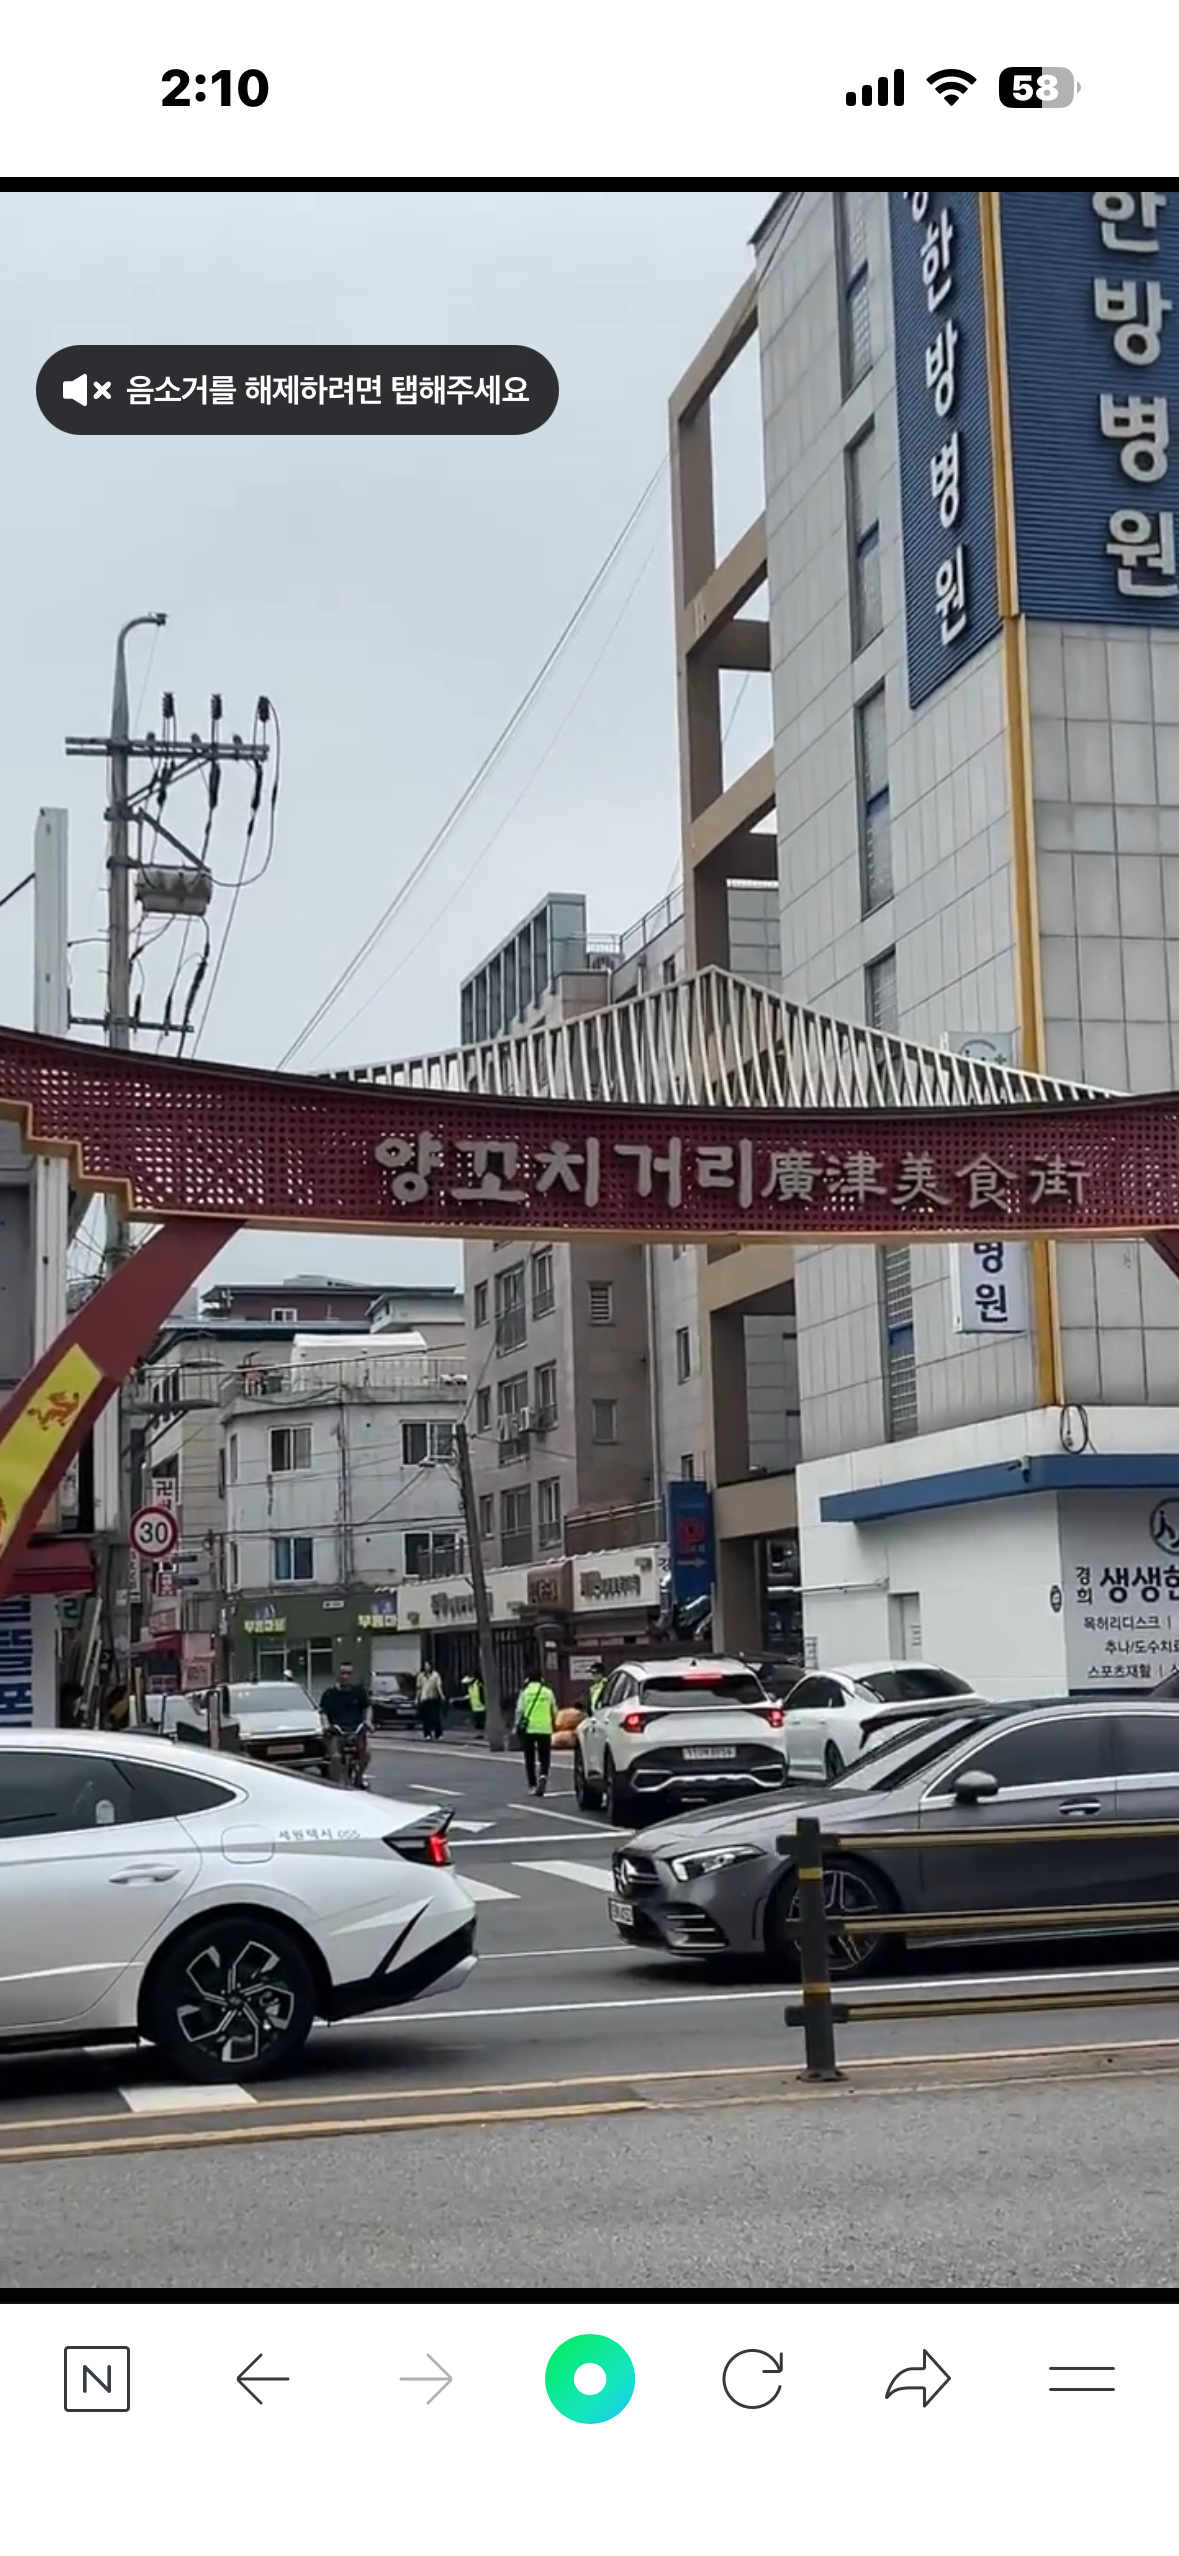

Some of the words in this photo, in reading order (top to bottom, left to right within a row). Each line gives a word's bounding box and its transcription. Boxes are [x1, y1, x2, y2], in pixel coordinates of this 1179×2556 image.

[1092, 192, 1179, 597] 한방병원
[375, 1131, 751, 1208] 양꼬치거리
[761, 1149, 1091, 1210] 廣津美食街
[974, 1242, 1007, 1322] 병원
[140, 1521, 168, 1544] 30
[1076, 1567, 1093, 1605] 경희
